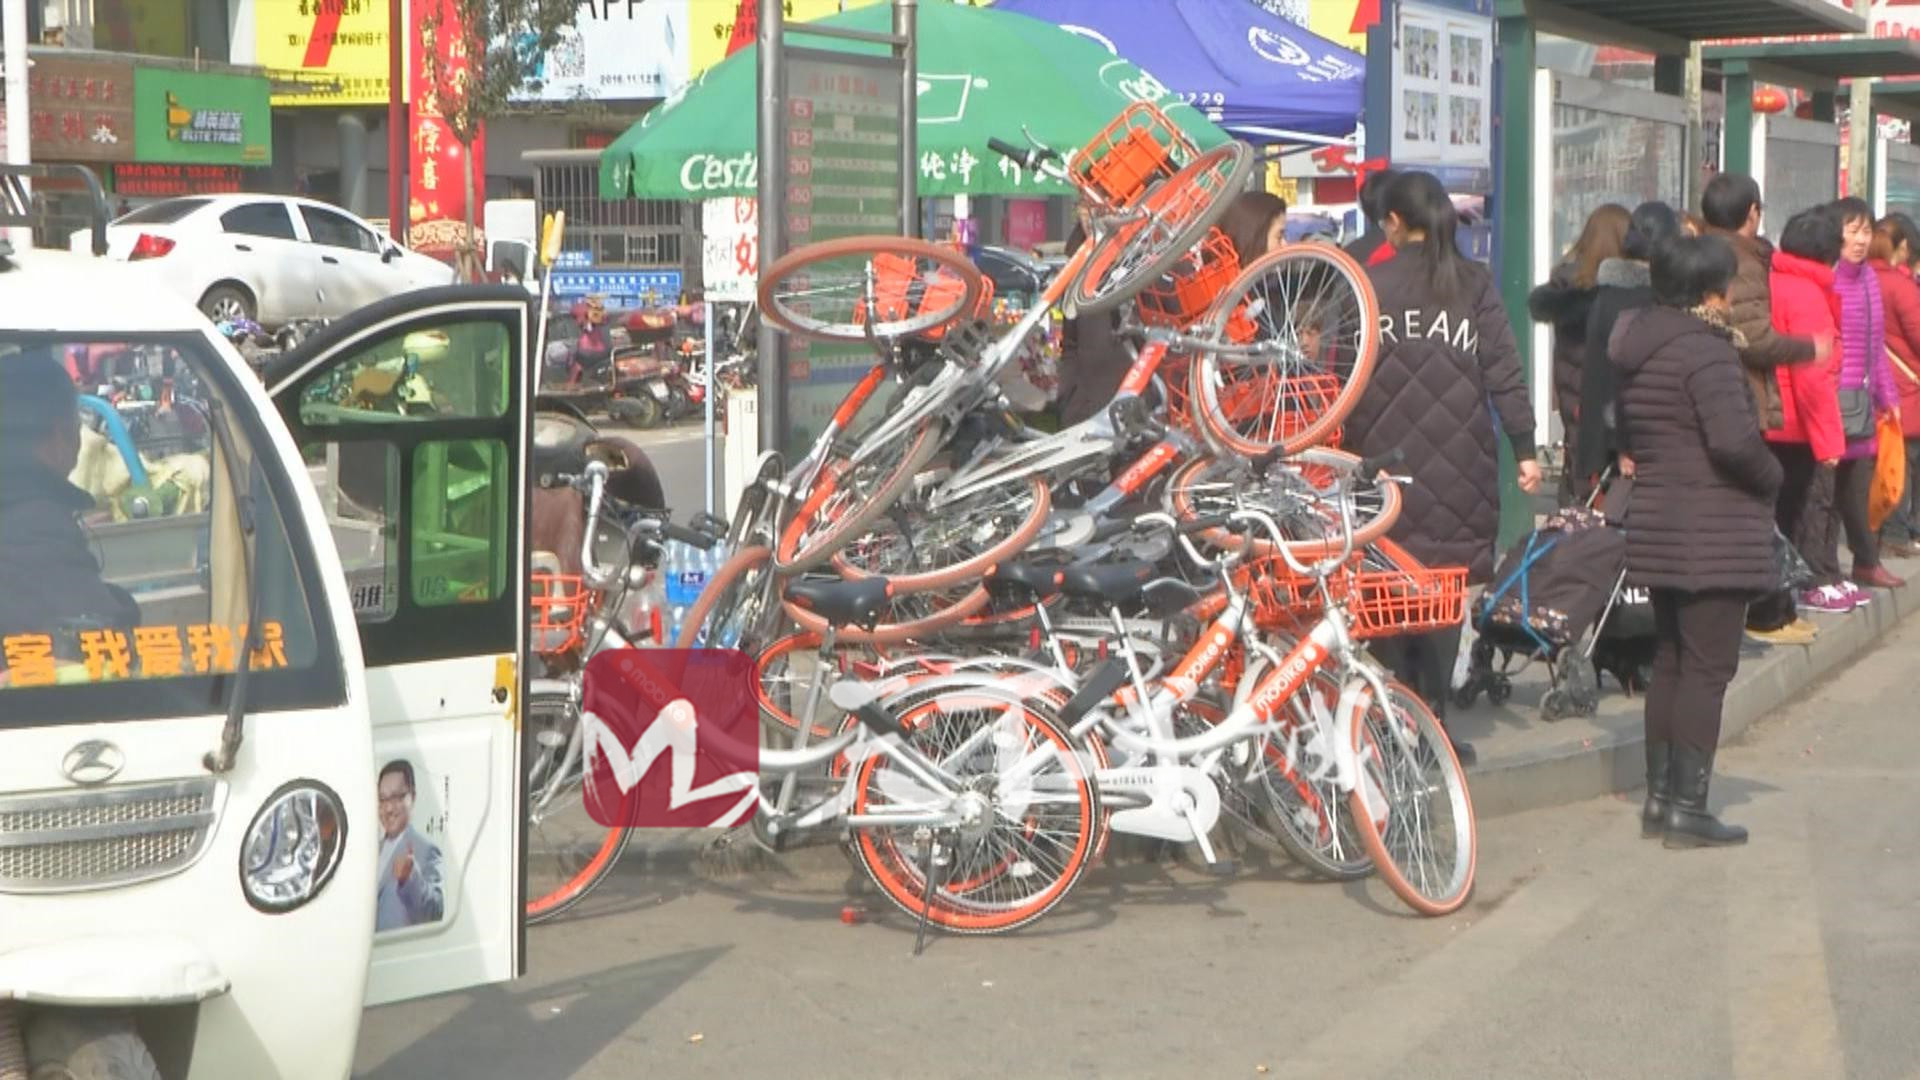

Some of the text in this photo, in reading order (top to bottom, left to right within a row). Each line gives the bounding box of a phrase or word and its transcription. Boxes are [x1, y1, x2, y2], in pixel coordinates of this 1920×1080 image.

[791, 131, 810, 146] 12
[1354, 309, 1479, 355] REAM
[3, 633, 56, 685] 客
